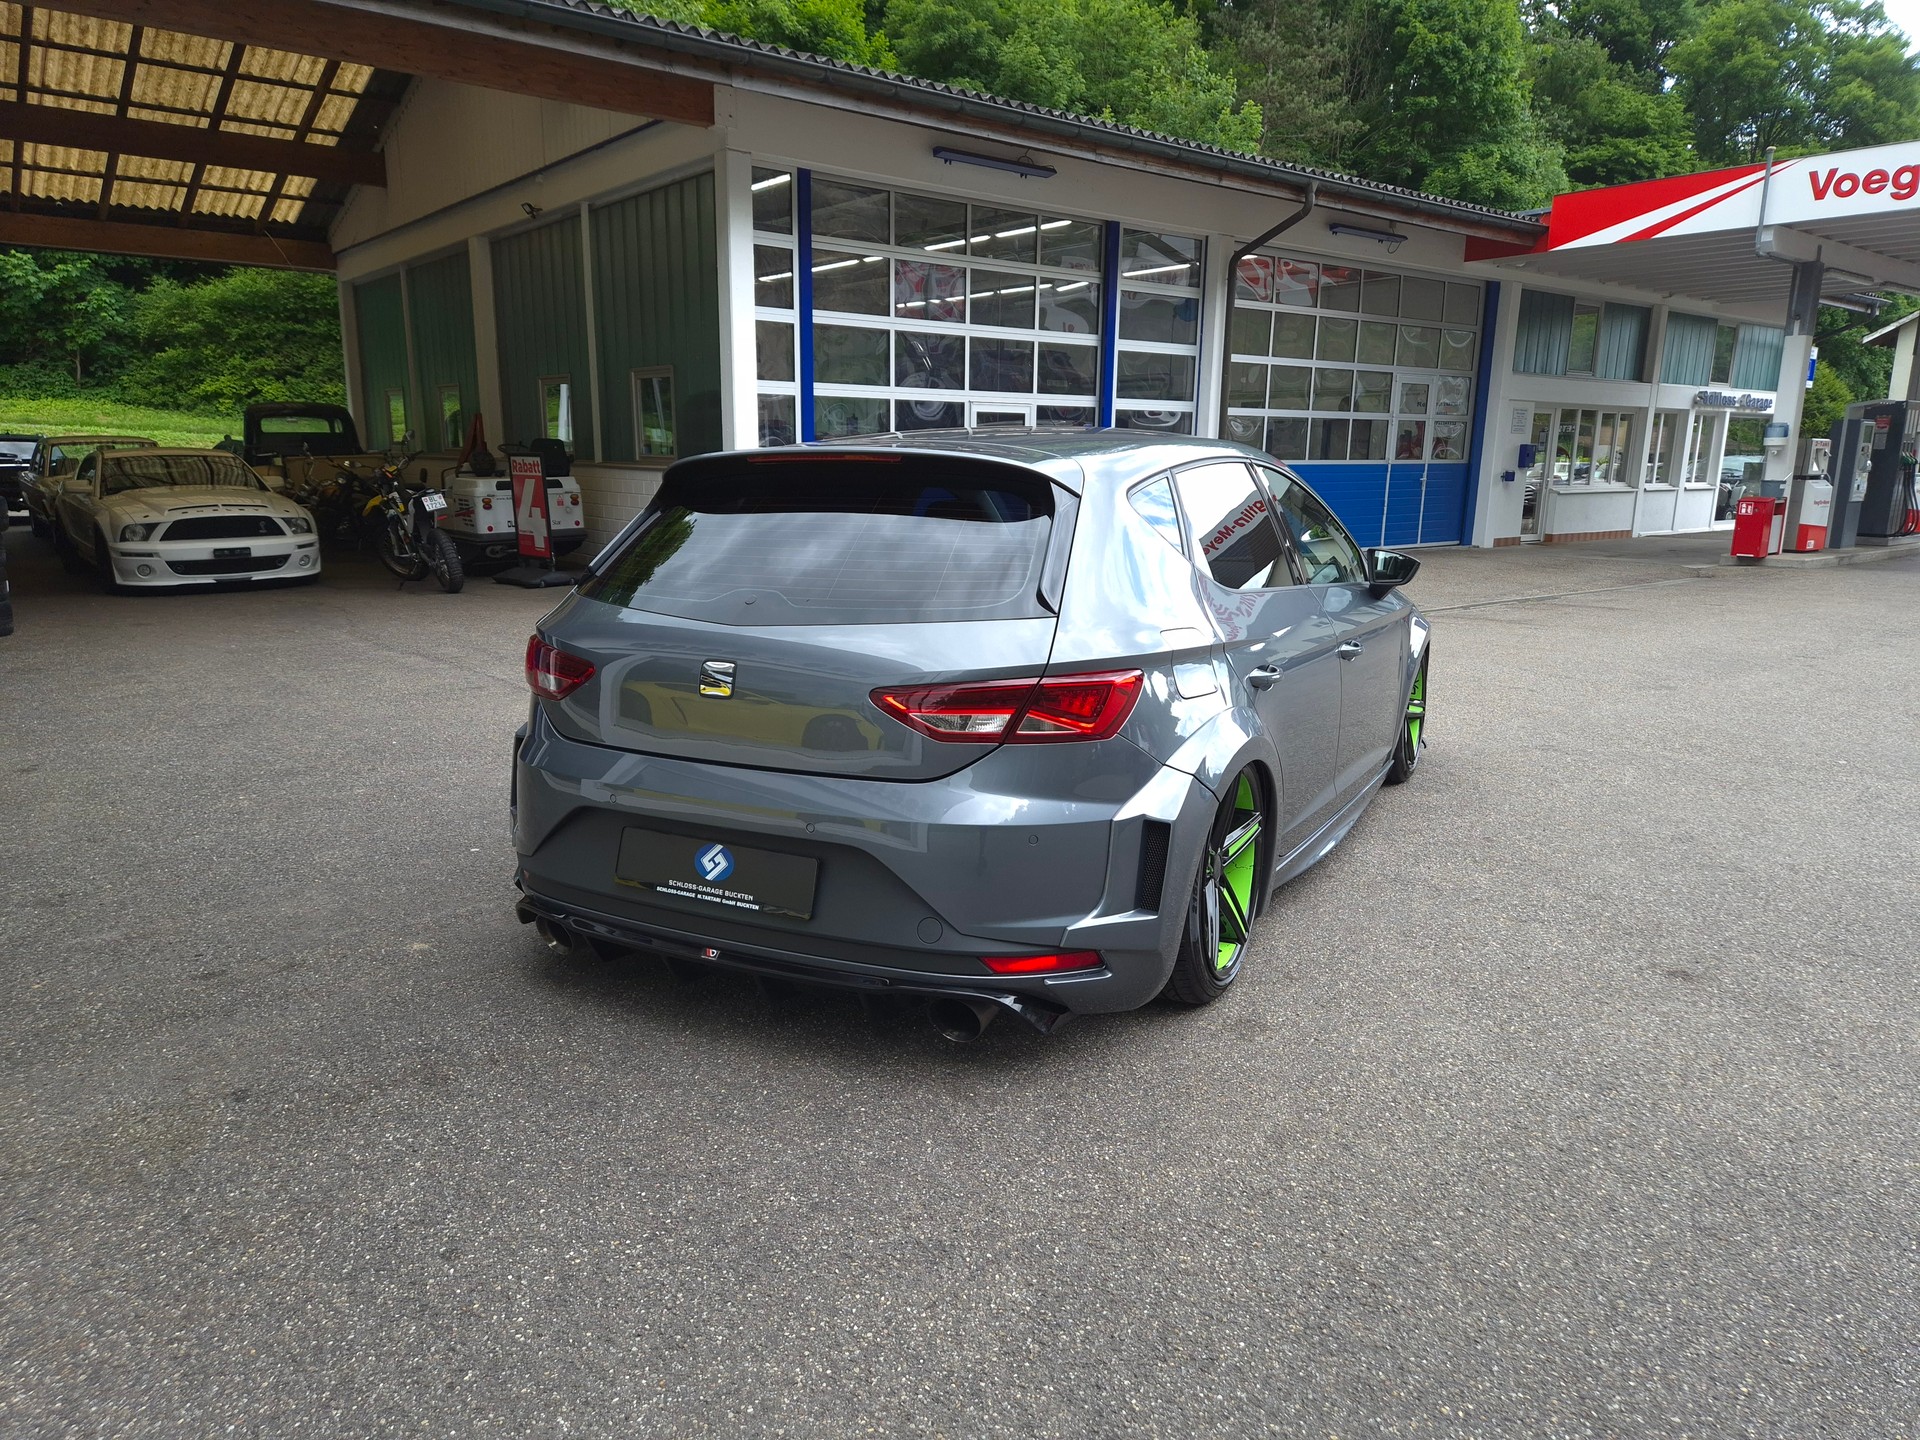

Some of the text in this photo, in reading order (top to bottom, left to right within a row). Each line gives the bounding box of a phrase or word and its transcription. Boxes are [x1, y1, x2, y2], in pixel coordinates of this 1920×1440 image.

[1809, 164, 1920, 201] Voeg
[512, 459, 541, 474] Rabatt
[656, 886, 696, 898] SCHLOSS-GARAGE
[737, 901, 759, 910] BUCKTEN
[669, 880, 753, 901] SCHLOSS-GARAGE BUCKTEN
